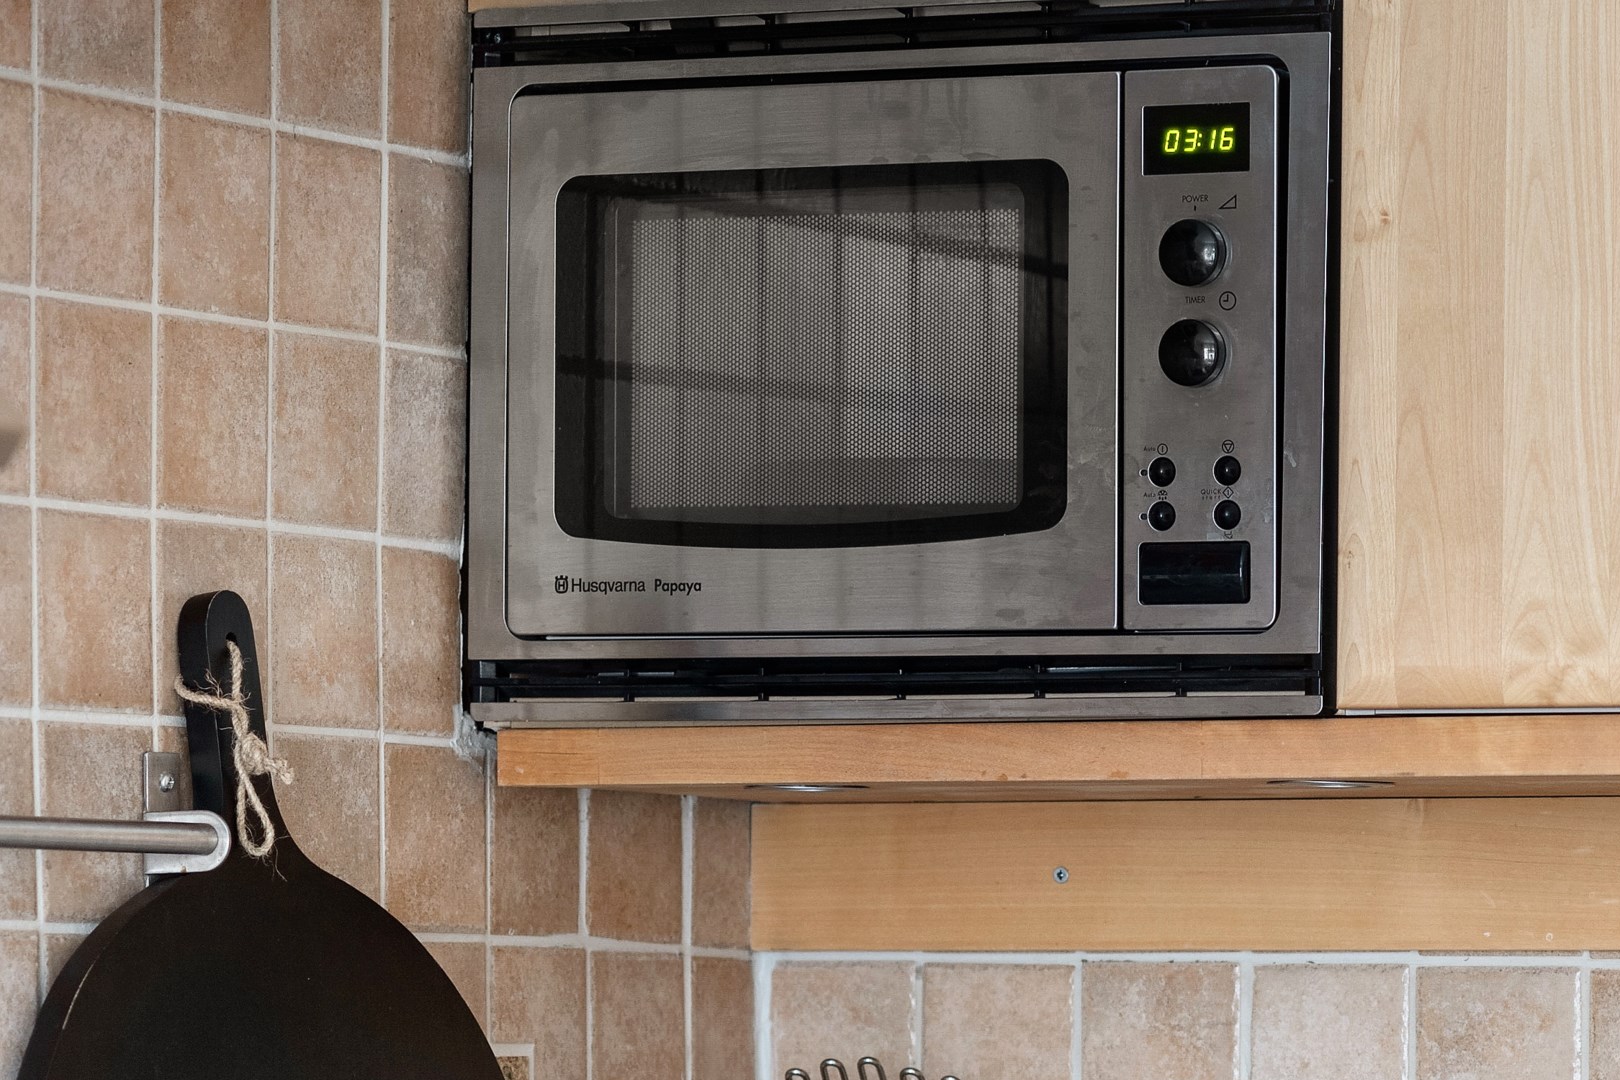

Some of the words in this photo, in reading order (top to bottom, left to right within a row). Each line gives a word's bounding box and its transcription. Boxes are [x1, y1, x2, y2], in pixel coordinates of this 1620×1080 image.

[1164, 127, 1234, 153] 03:16
[1182, 194, 1208, 203] POWER
[571, 578, 646, 595] Husqvarna
[654, 578, 702, 596] Papaya
